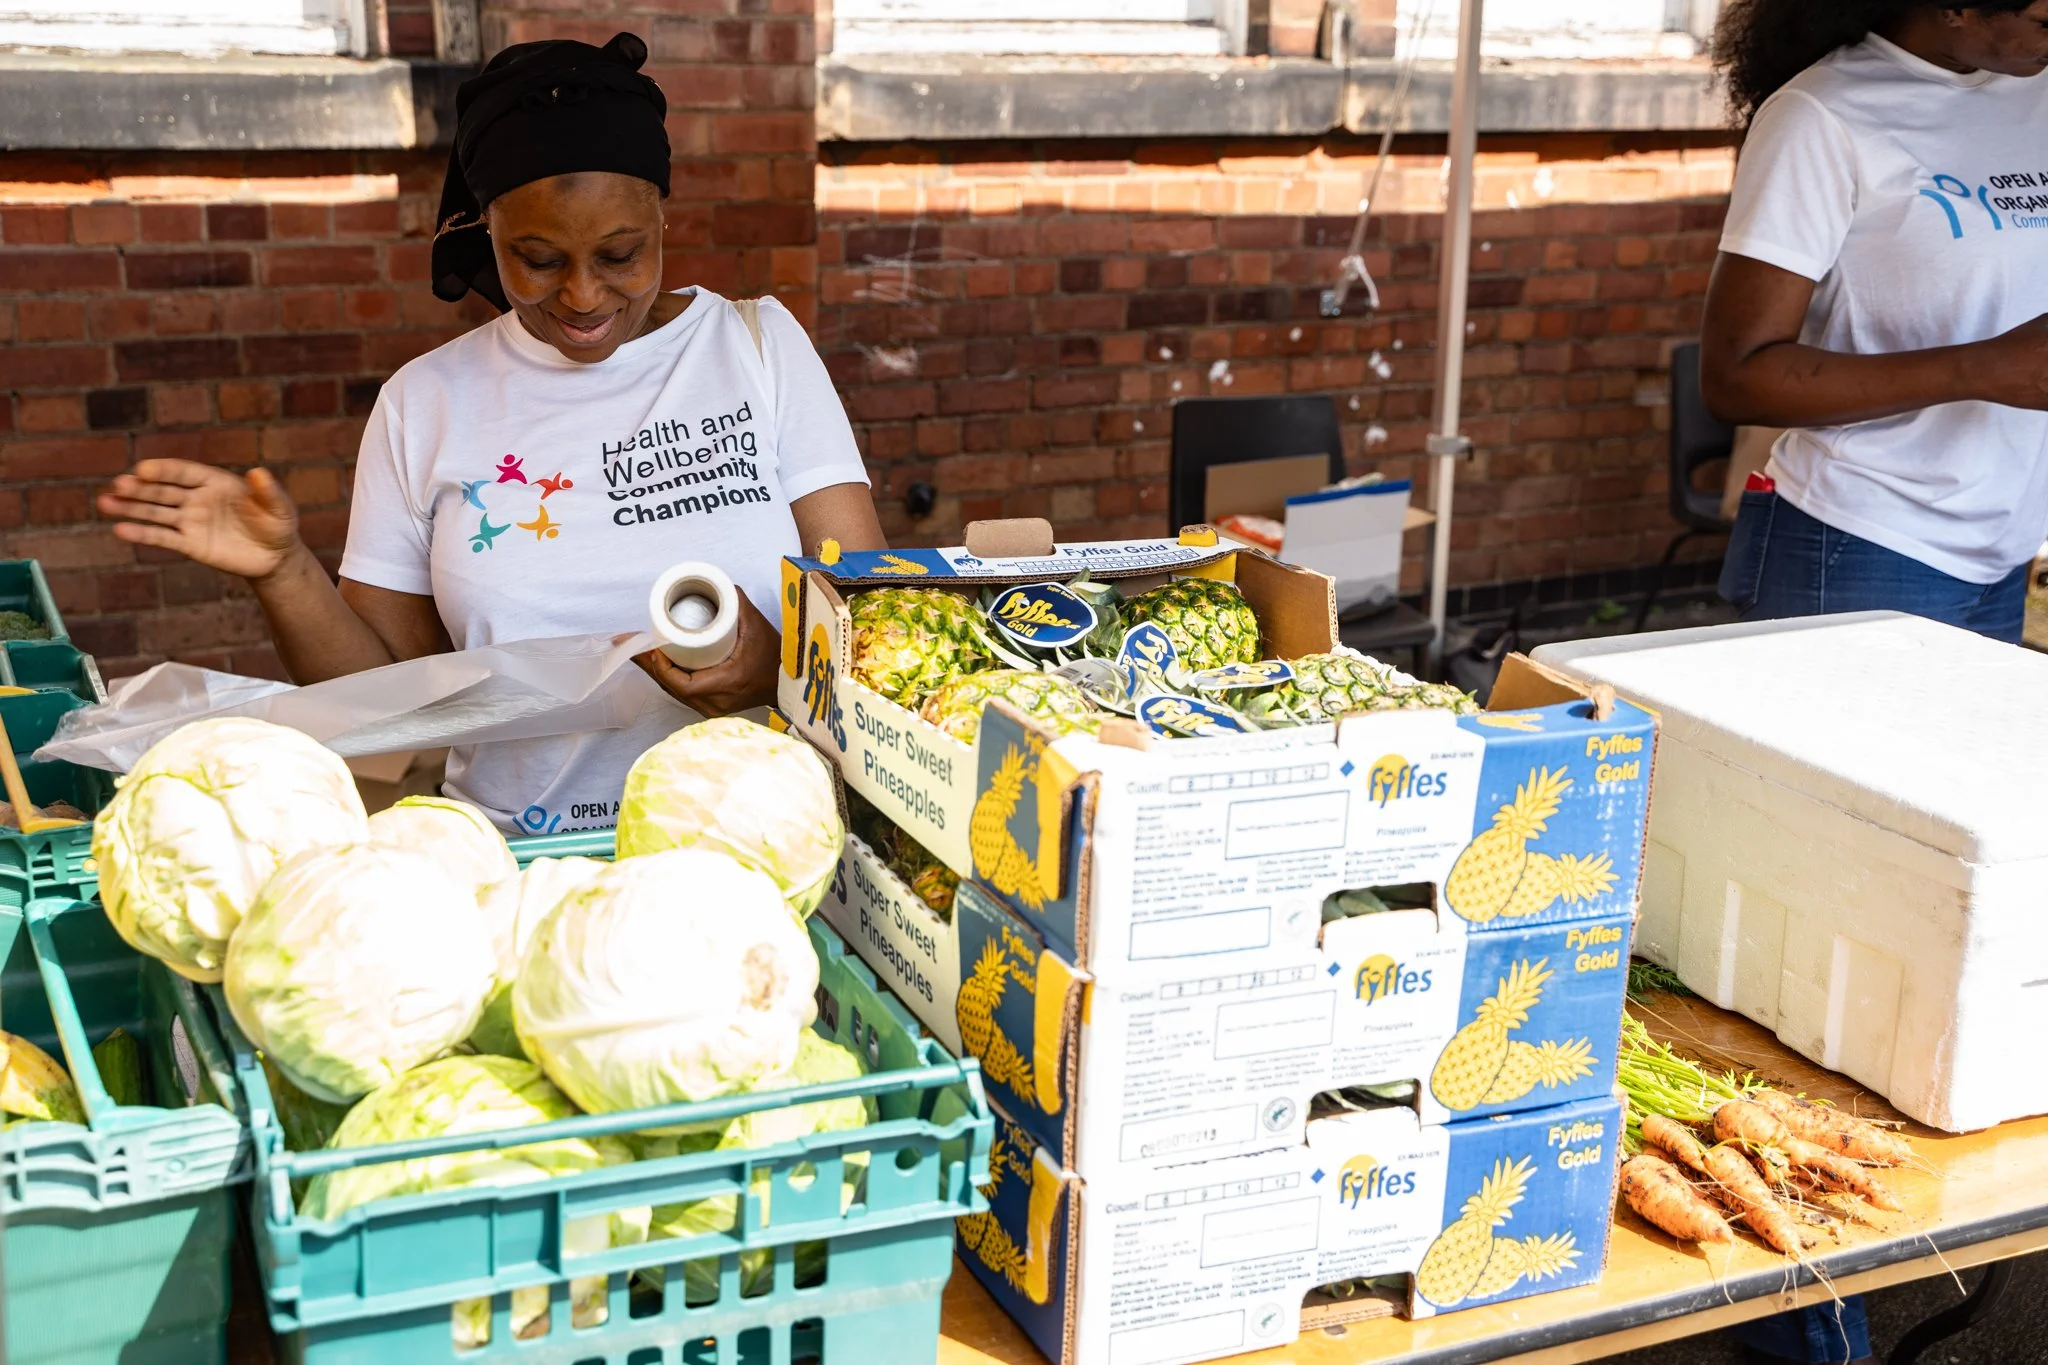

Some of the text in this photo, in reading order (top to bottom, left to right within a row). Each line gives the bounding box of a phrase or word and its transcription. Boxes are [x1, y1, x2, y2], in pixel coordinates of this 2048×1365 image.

[1989, 173, 2038, 189] OPEN
[602, 401, 753, 464] Health and
[603, 431, 757, 488] Wellbeing
[607, 457, 759, 501] Community
[613, 485, 771, 526] Champions
[1063, 543, 1169, 558] Fyffes Gold
[1006, 620, 1038, 638] Gold
[854, 701, 952, 786] Super Sweet
[1586, 733, 1643, 761] Fyffes
[1594, 759, 1640, 784] Gold
[864, 748, 945, 830] Pineapples
[571, 802, 608, 819] OPEN
[853, 860, 890, 917] Super
[894, 900, 938, 964] Sweet
[1566, 925, 1623, 952] Fyffes
[861, 907, 934, 1003] Pineapples
[1575, 949, 1620, 973] Gold
[1547, 1121, 1604, 1150] Fyffes
[1557, 1144, 1602, 1171] Gold
